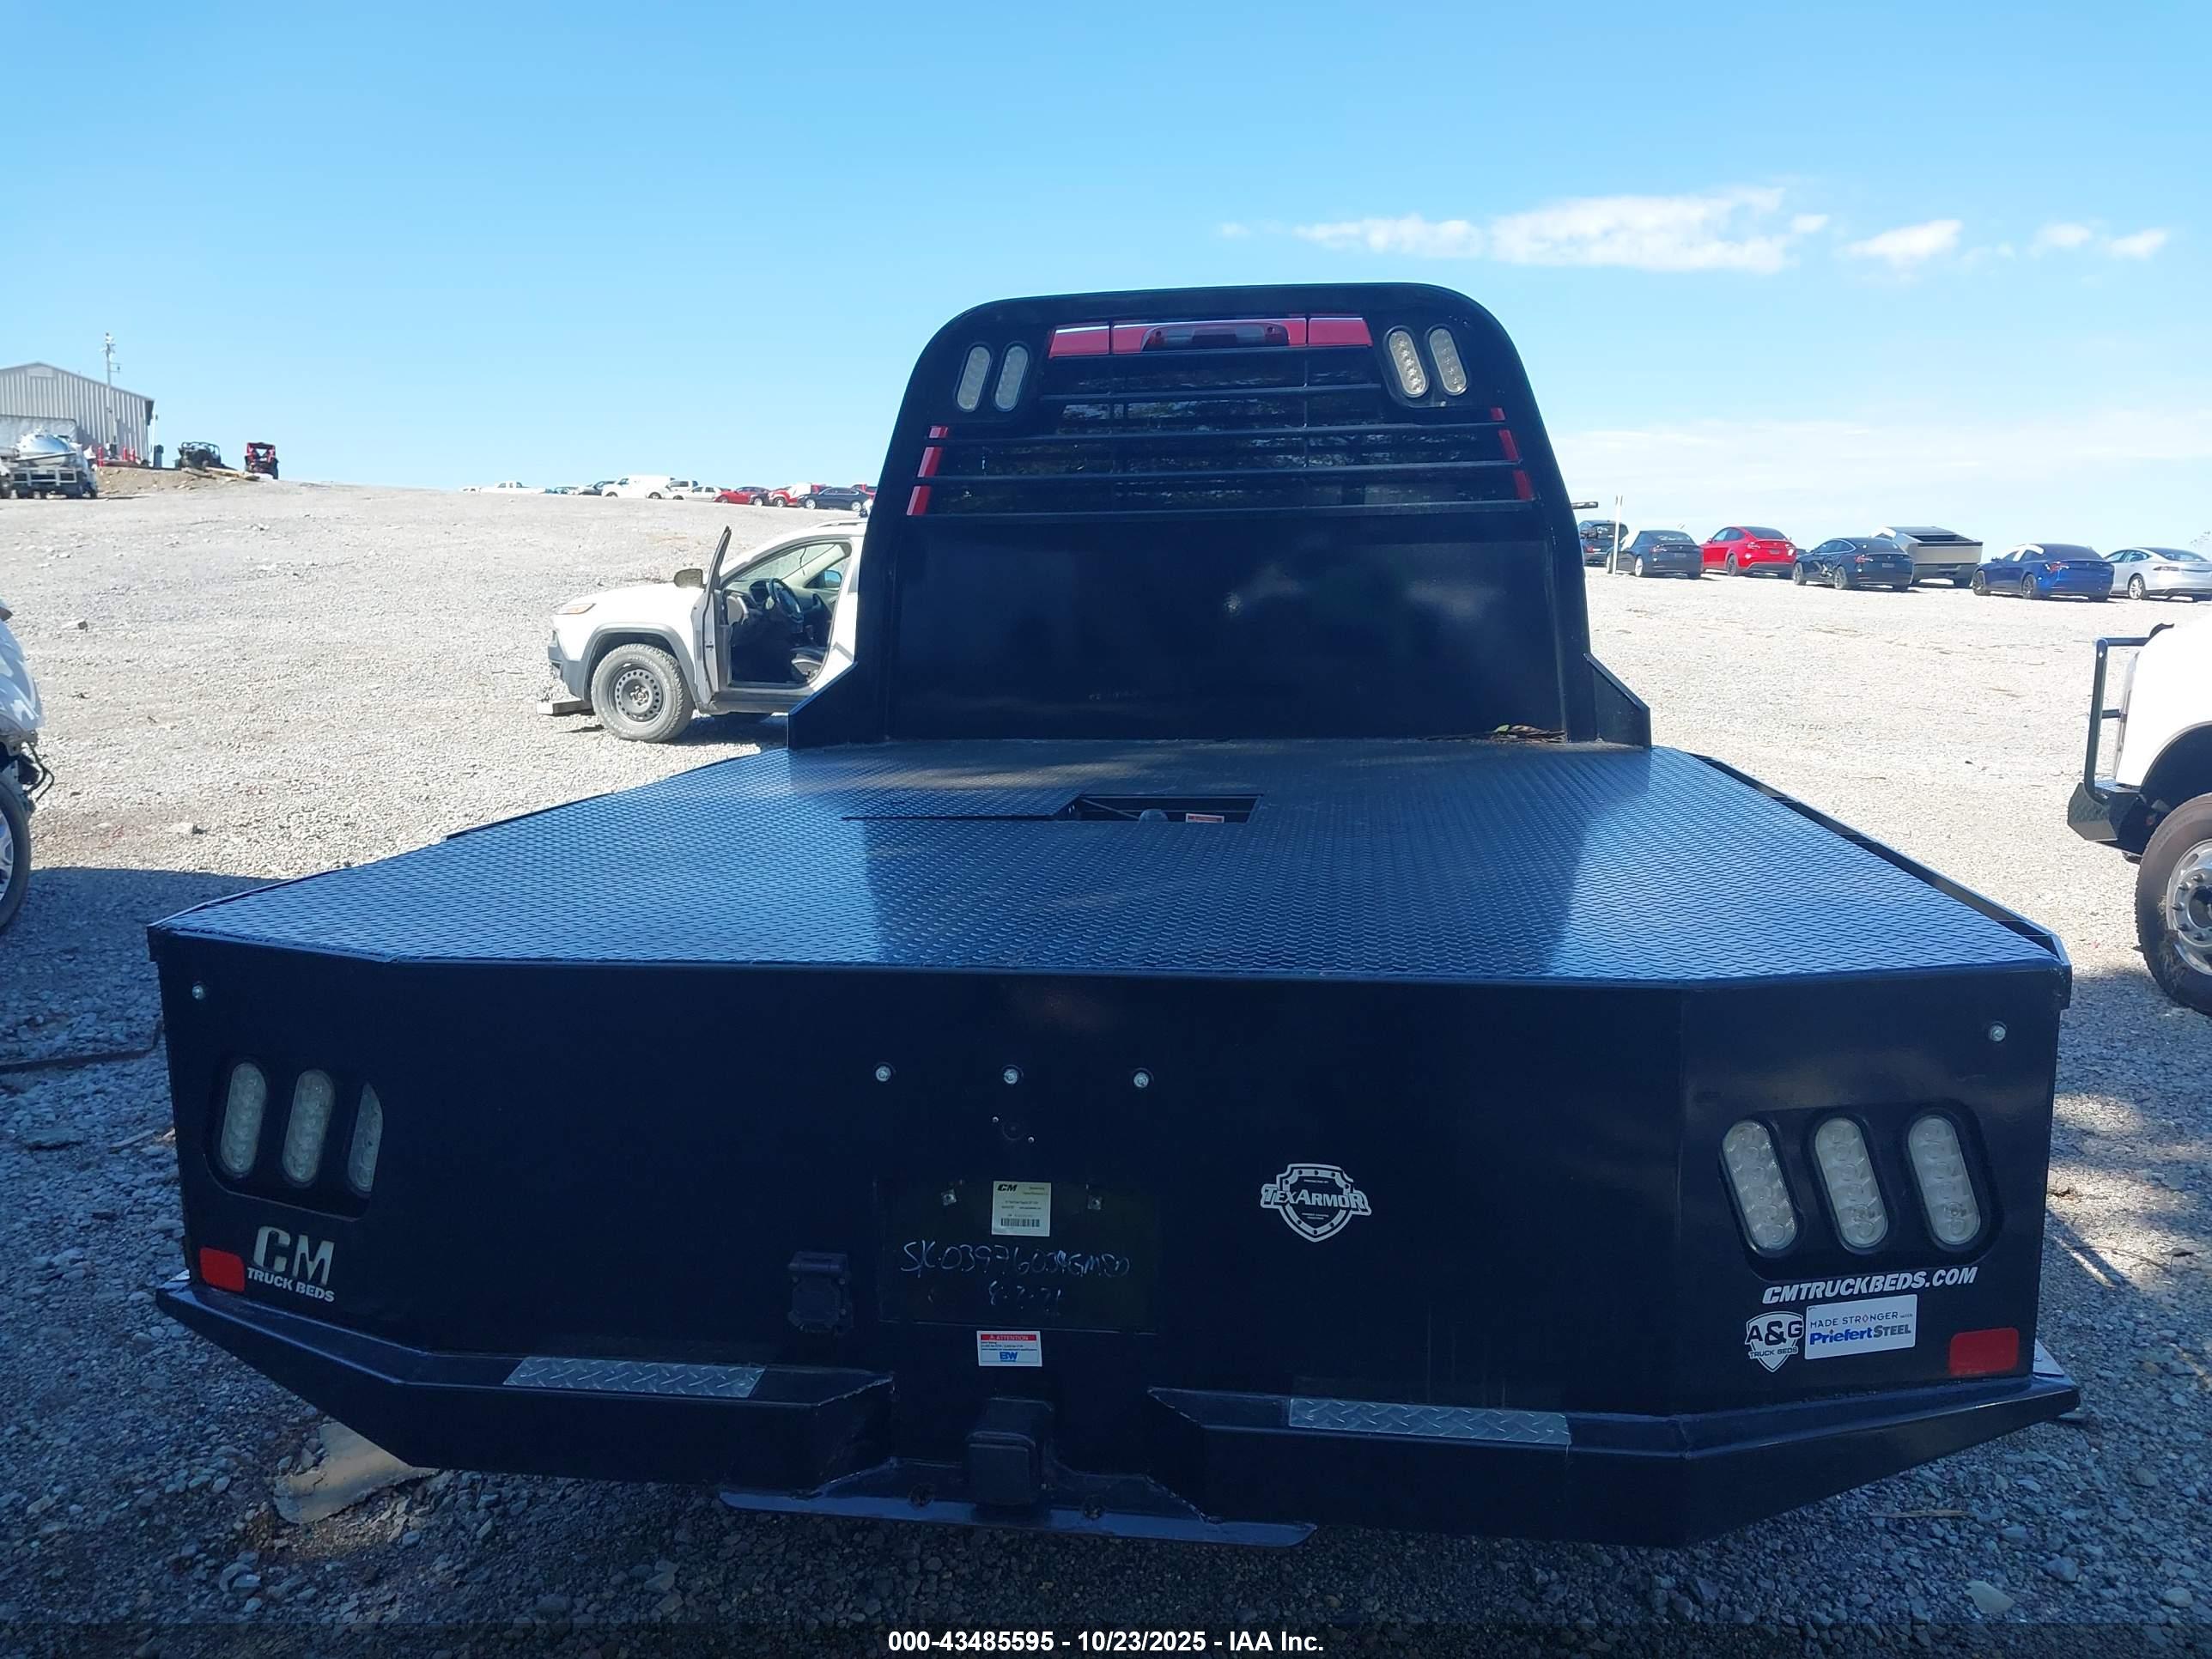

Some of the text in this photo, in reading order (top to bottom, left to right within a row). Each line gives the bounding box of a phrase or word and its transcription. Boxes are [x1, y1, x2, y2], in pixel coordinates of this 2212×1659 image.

[997, 1183, 1018, 1192] CM
[253, 1225, 336, 1286] CM
[247, 1267, 336, 1303] TRUCK BEDS
[1761, 1267, 1978, 1304] CMTRUCKBEDS.COM
[1810, 1318, 1838, 1328] MADE
[1842, 1311, 1899, 1325] STRONGER
[1746, 1320, 1803, 1346] A&G
[1749, 1346, 1798, 1358] TRUCK BEDS
